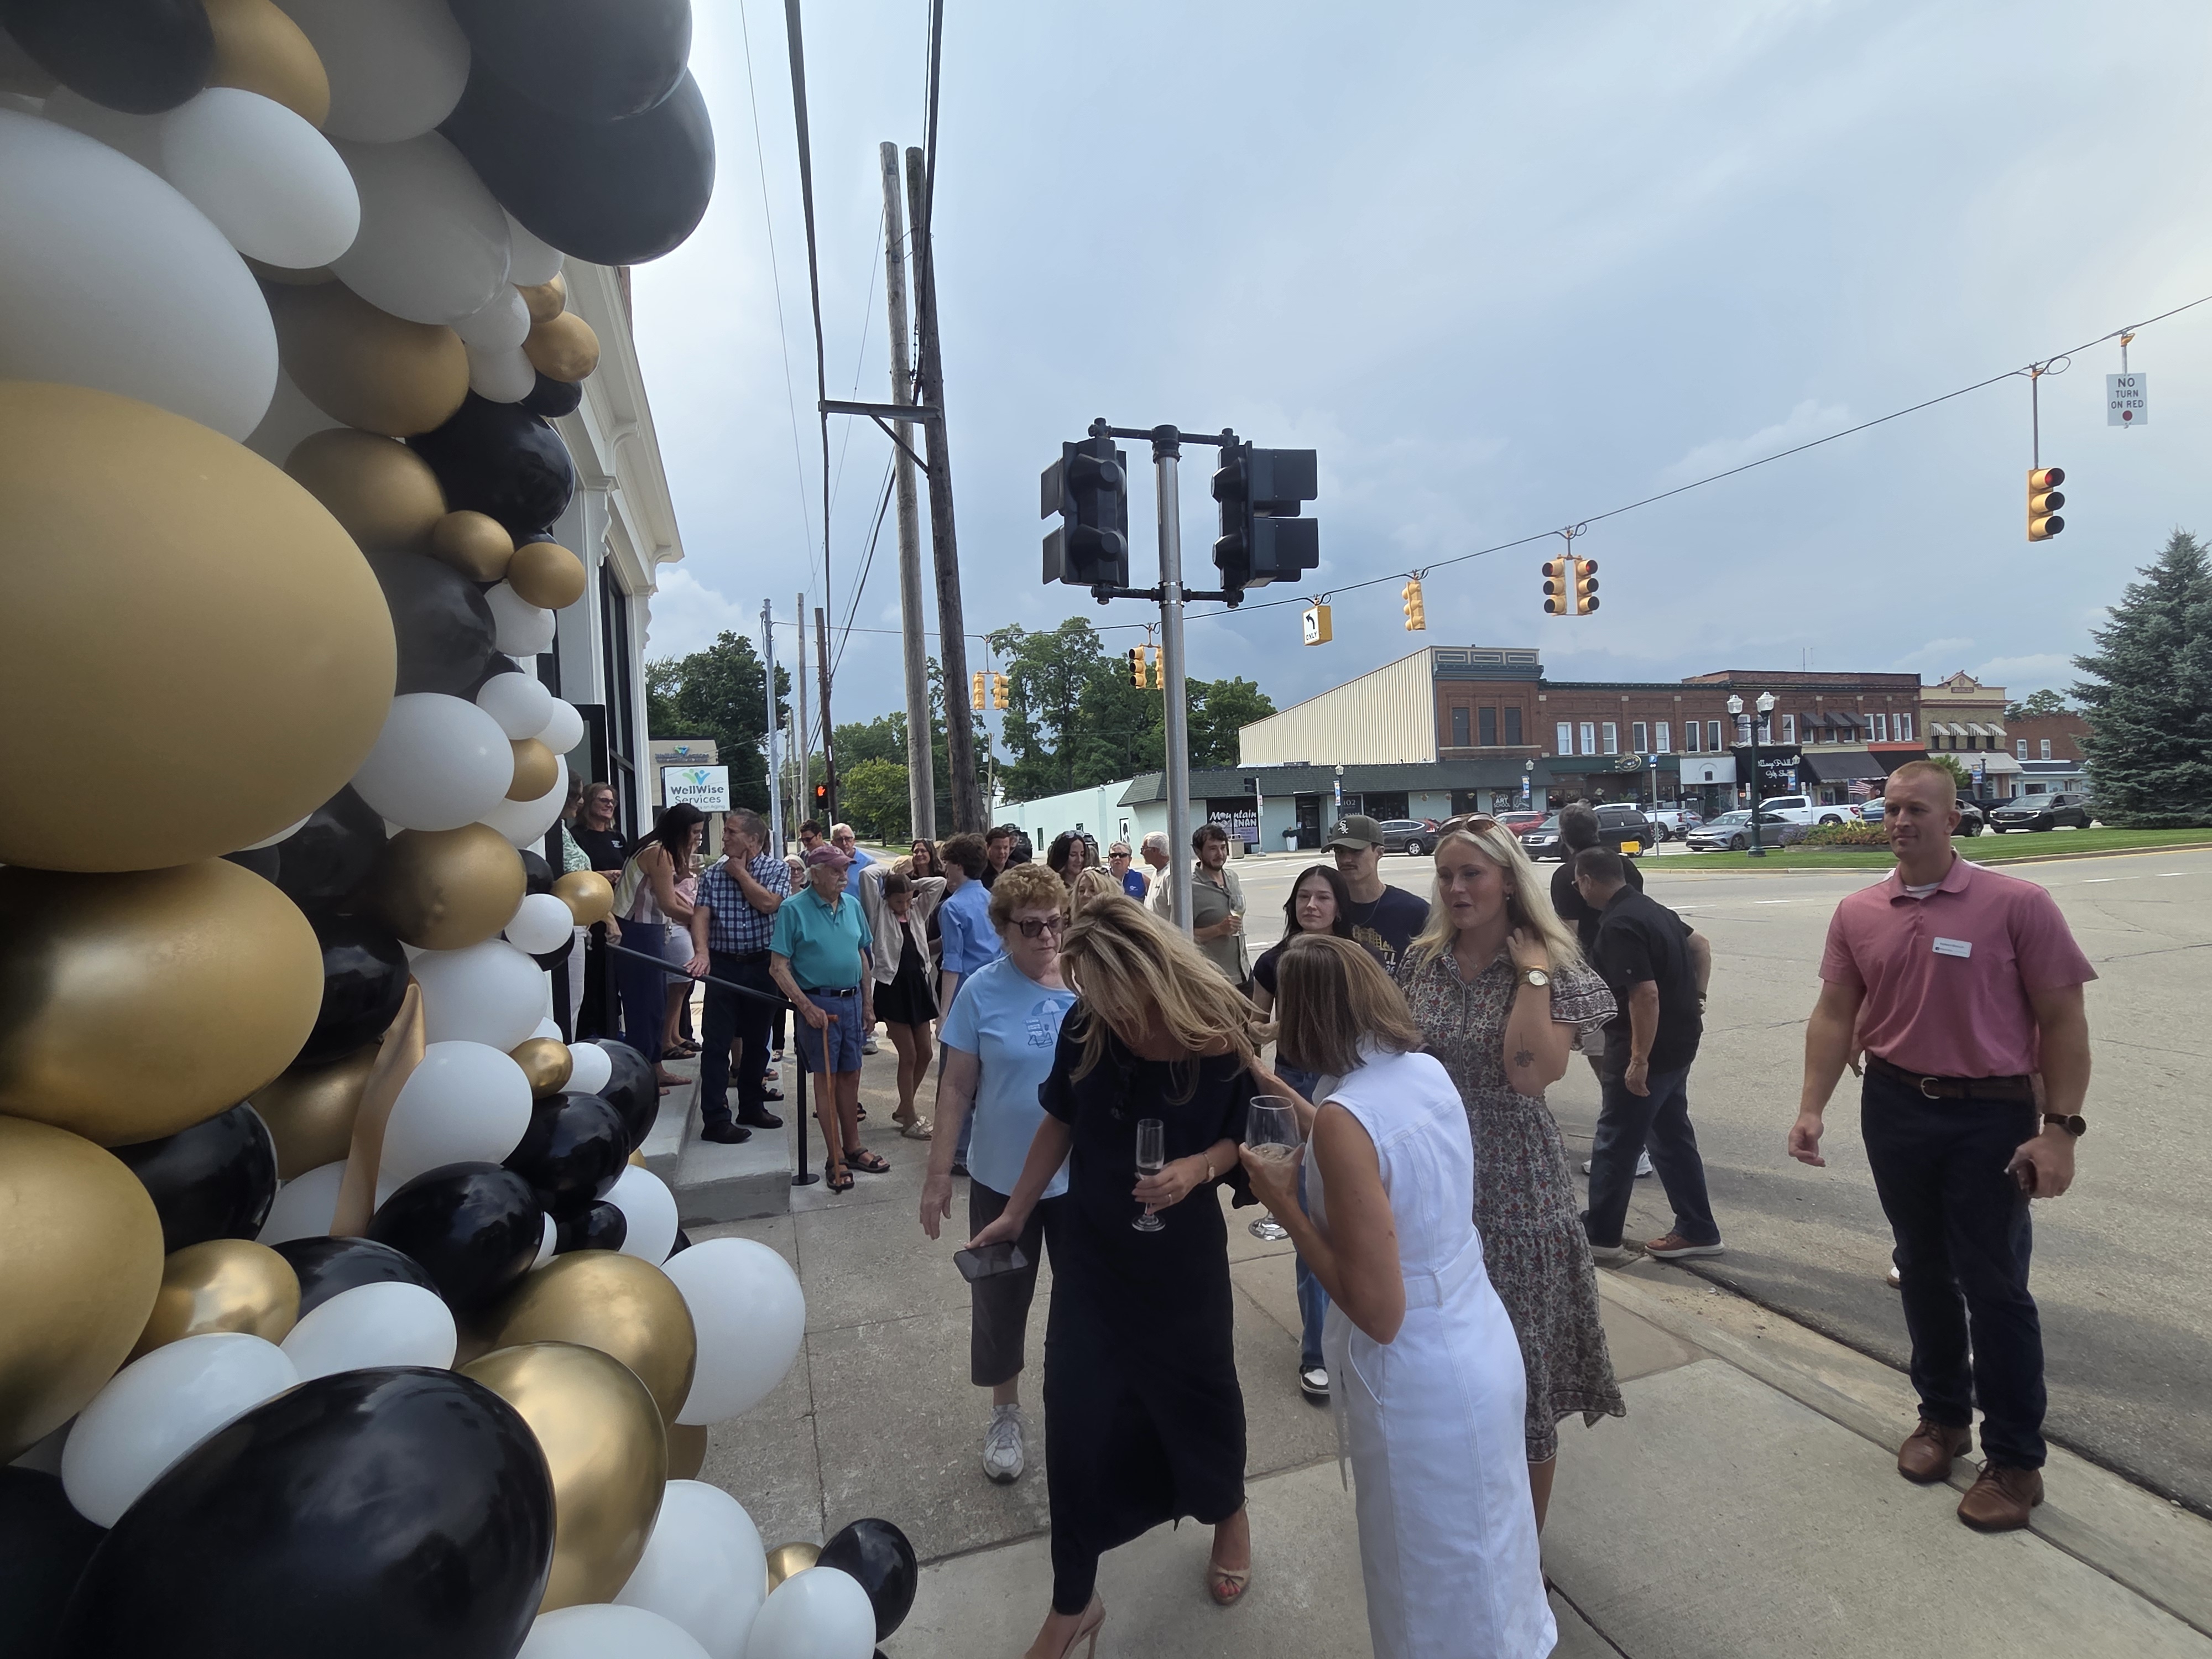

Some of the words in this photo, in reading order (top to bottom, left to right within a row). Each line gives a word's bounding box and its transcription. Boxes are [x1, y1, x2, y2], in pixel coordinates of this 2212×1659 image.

[2117, 377, 2135, 388] NO
[2115, 389, 2138, 398] TURN
[2111, 400, 2123, 409] ON
[2126, 399, 2144, 408] RED
[1306, 631, 1317, 640] ONLY
[670, 785, 724, 795] WellWise
[675, 795, 721, 804] Services
[1209, 809, 1256, 821] Mountain
